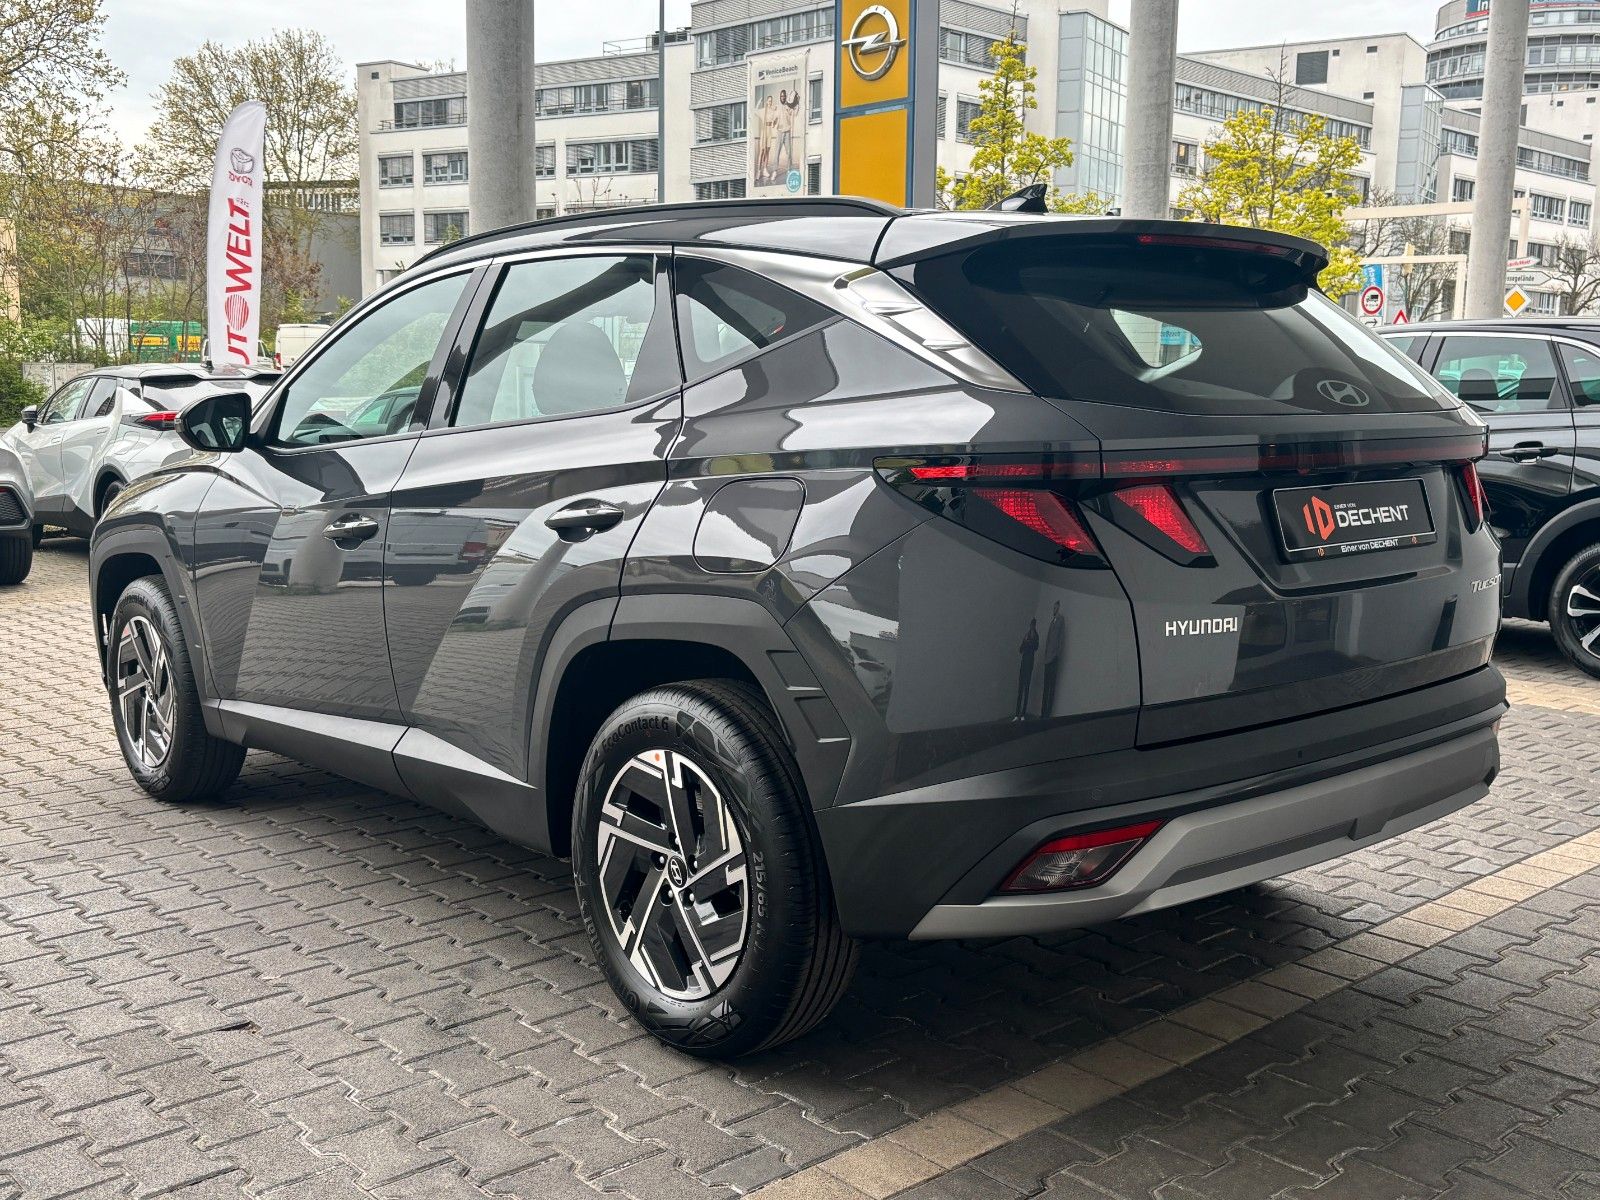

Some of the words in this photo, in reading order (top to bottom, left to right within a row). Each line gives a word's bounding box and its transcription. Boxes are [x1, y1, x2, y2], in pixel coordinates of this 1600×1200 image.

[1335, 504, 1408, 528] DECHENT
[1340, 544, 1358, 553] Einer
[1358, 543, 1370, 551] von
[1369, 538, 1399, 550] DECHENT
[1165, 616, 1238, 637] HYUNDAI
[601, 716, 661, 754] EcoContact
